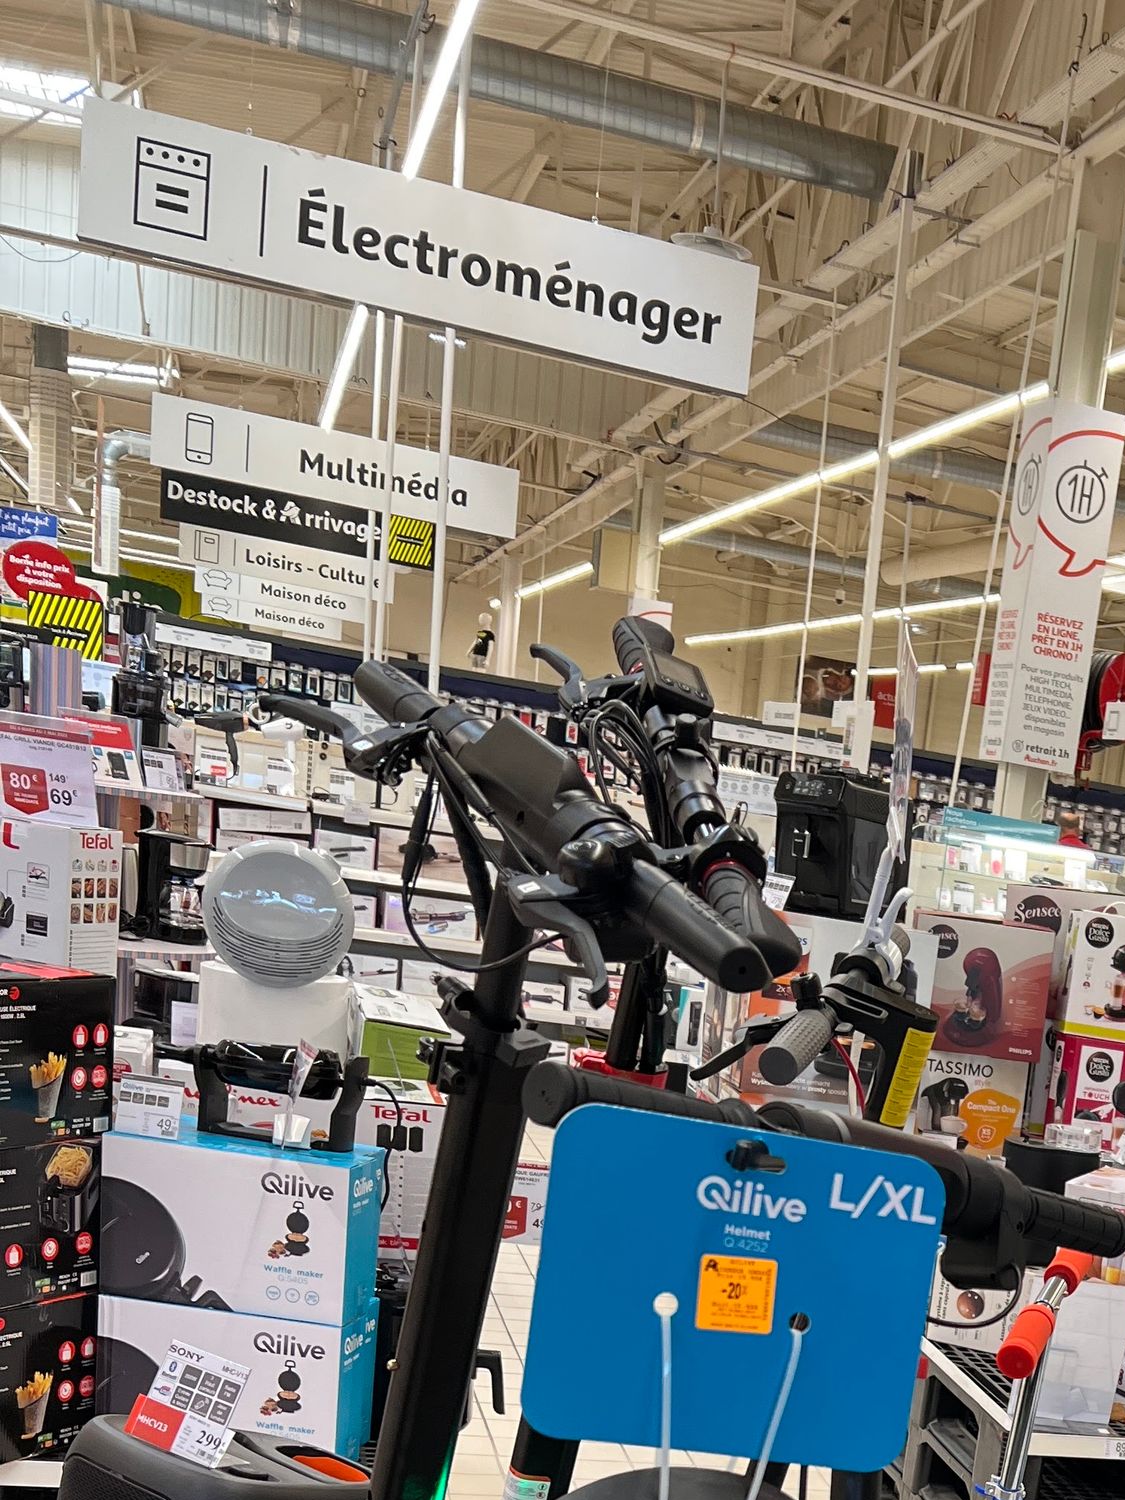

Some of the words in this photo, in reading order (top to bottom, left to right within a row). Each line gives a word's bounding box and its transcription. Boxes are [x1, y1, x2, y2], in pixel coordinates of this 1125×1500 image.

[297, 188, 722, 346] Électroménager
[167, 480, 257, 517] Destock
[262, 499, 277, 518] &
[35, 558, 52, 570] info
[53, 564, 70, 575] prix
[245, 548, 302, 574] Loisirs
[319, 564, 380, 590] Cultue
[261, 583, 310, 605] Maison
[314, 594, 346, 611] déco
[255, 608, 296, 626] Maison
[298, 615, 325, 630] déco
[1037, 612, 1084, 631] RÉSERVEZ
[1037, 624, 1050, 634] EN
[1033, 645, 1073, 662] CHRONO
[1056, 638, 1070, 649] EN
[1071, 641, 1083, 653] 1H
[1020, 663, 1039, 673] Pour
[1026, 743, 1056, 757] retrait
[80, 832, 114, 849] Tefal
[1008, 1047, 1033, 1056] PHILIPS
[926, 1058, 994, 1078] TASSIMO
[261, 1171, 334, 1202] Qilive
[696, 1175, 808, 1223] Qilive
[829, 1172, 937, 1226] L/XL
[724, 1224, 771, 1241] Helmet
[263, 1263, 293, 1277] Waffle
[297, 1268, 324, 1280] maker
[169, 1344, 204, 1362] SONY
[253, 1330, 326, 1360] Qilive
[137, 1413, 169, 1432] MHCV13
